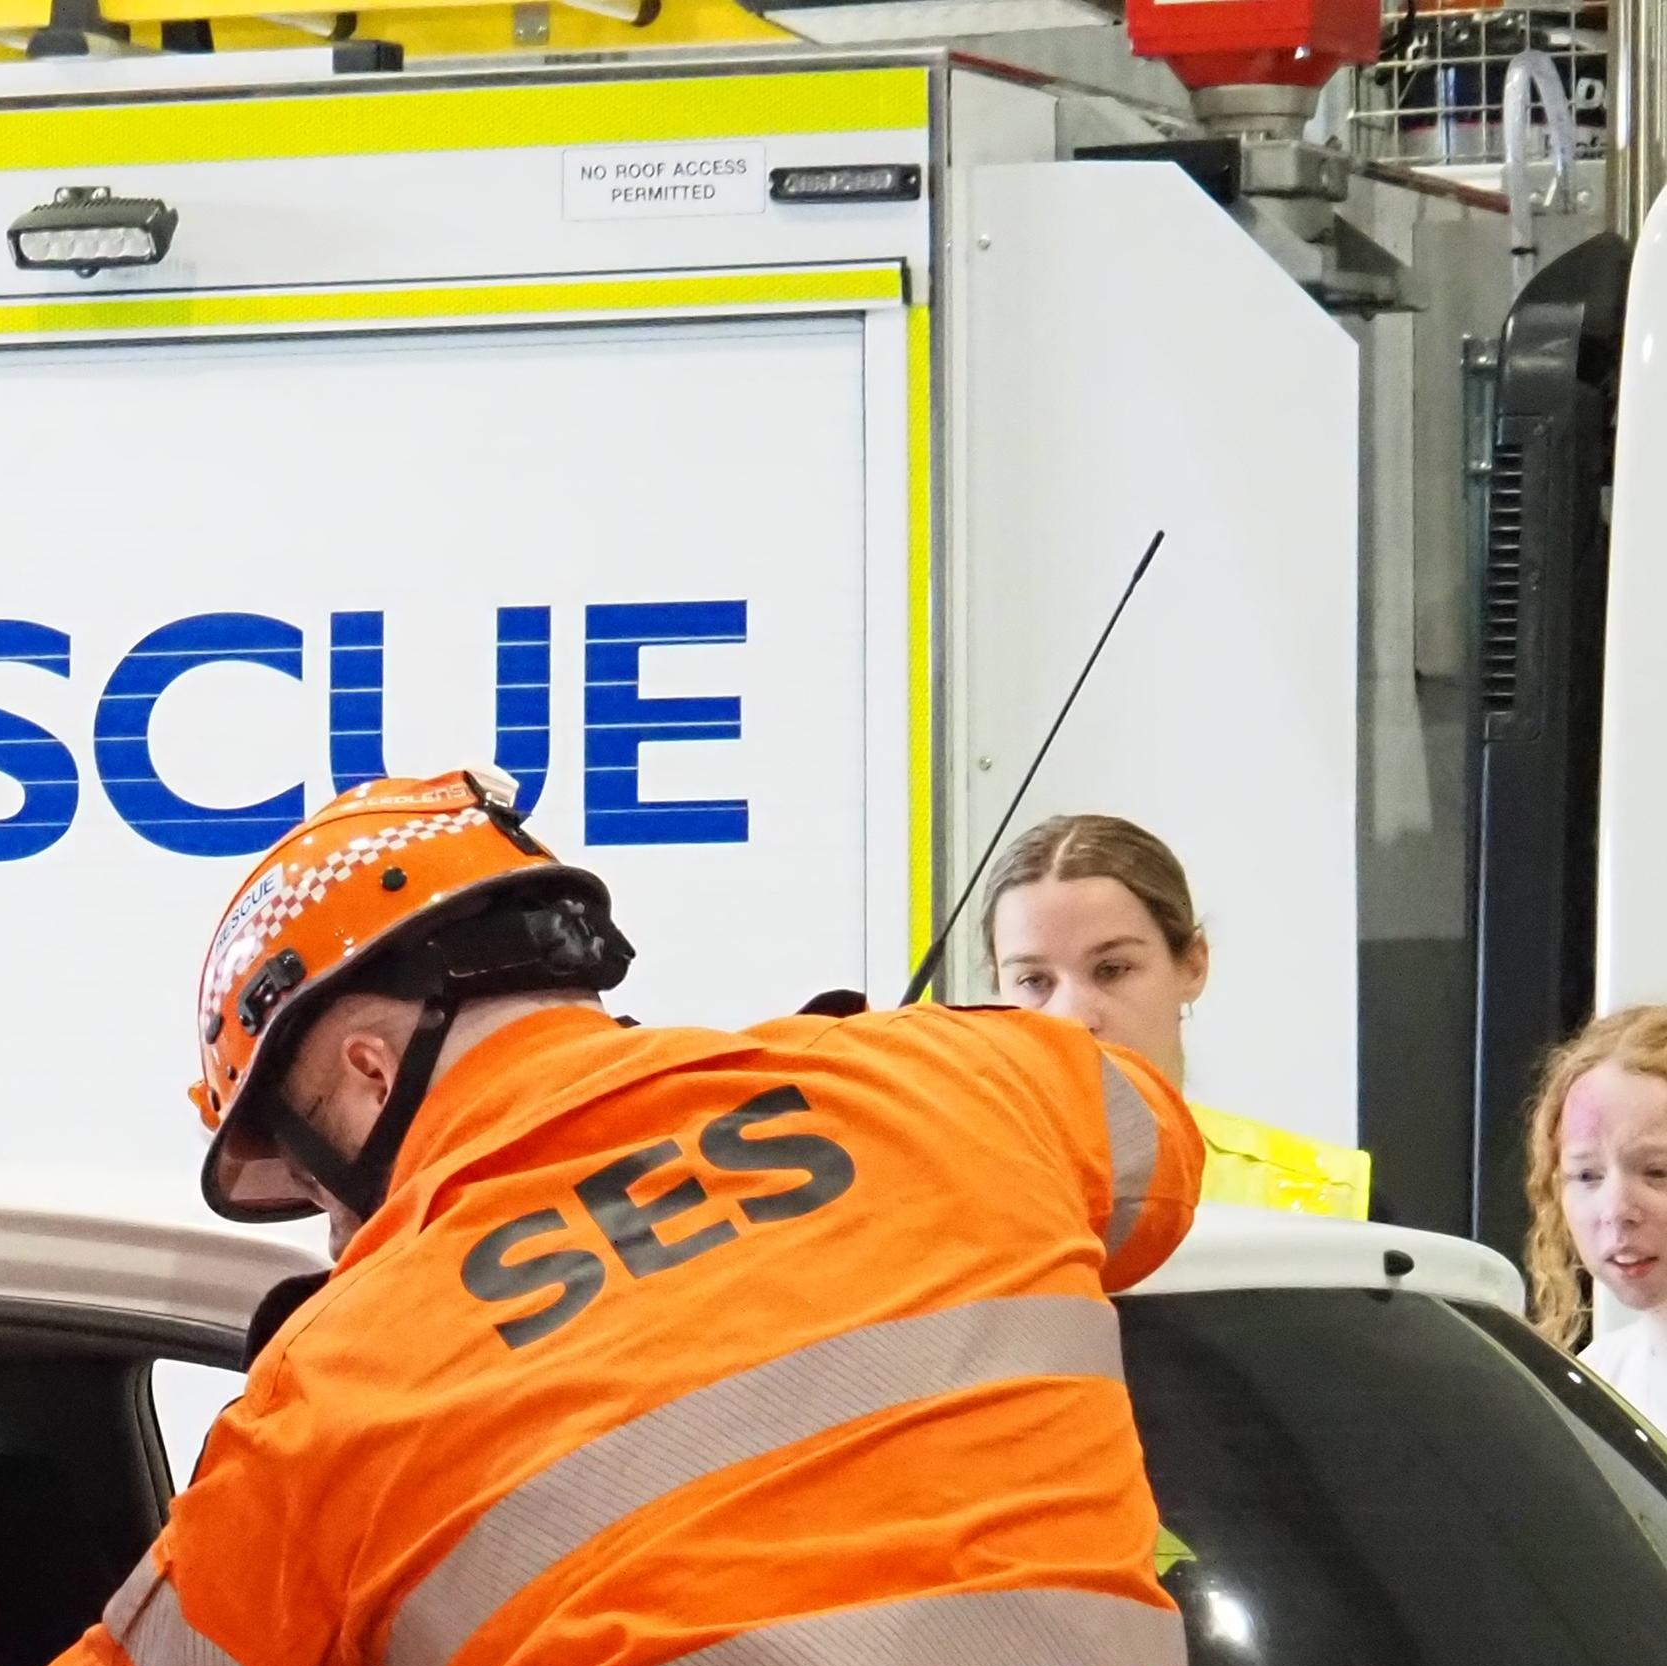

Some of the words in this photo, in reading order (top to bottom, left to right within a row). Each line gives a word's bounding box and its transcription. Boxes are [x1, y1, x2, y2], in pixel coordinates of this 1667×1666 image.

[580, 164, 607, 180] NO
[616, 162, 667, 179] ROOF
[673, 158, 748, 177] ACCESS
[611, 184, 716, 202] PERMITTED
[460, 1083, 857, 1350] SES
